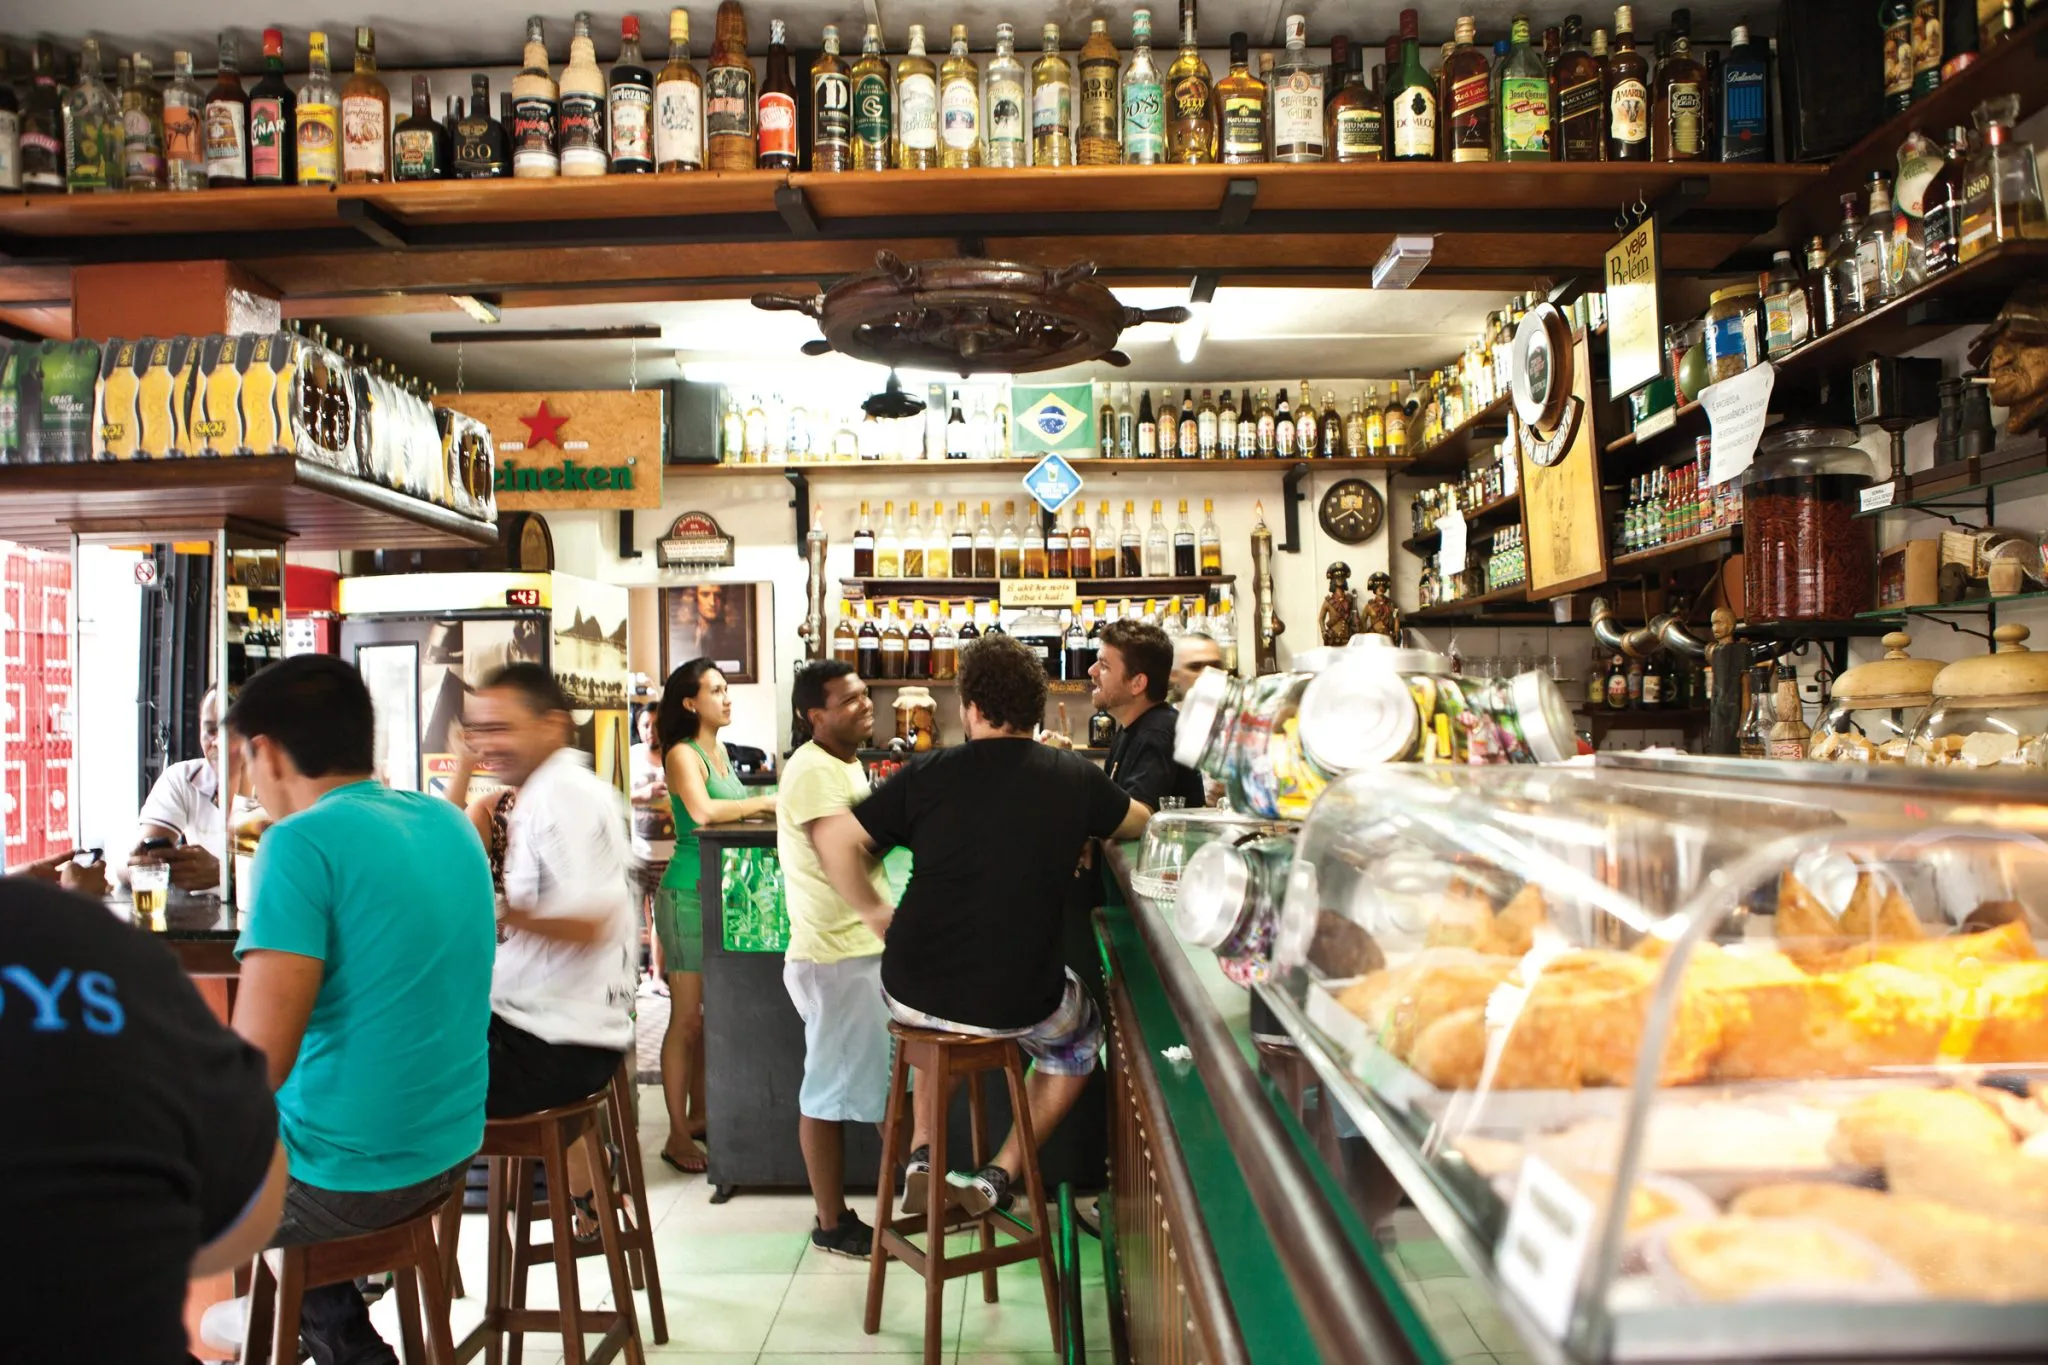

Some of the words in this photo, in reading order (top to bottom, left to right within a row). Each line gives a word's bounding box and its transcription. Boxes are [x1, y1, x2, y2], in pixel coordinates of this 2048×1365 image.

[1966, 174, 1990, 199] 1800
[1625, 231, 1648, 258] veja
[1610, 255, 1649, 286] Belém
[494, 459, 634, 491] eineken
[0, 965, 126, 1036] YS
